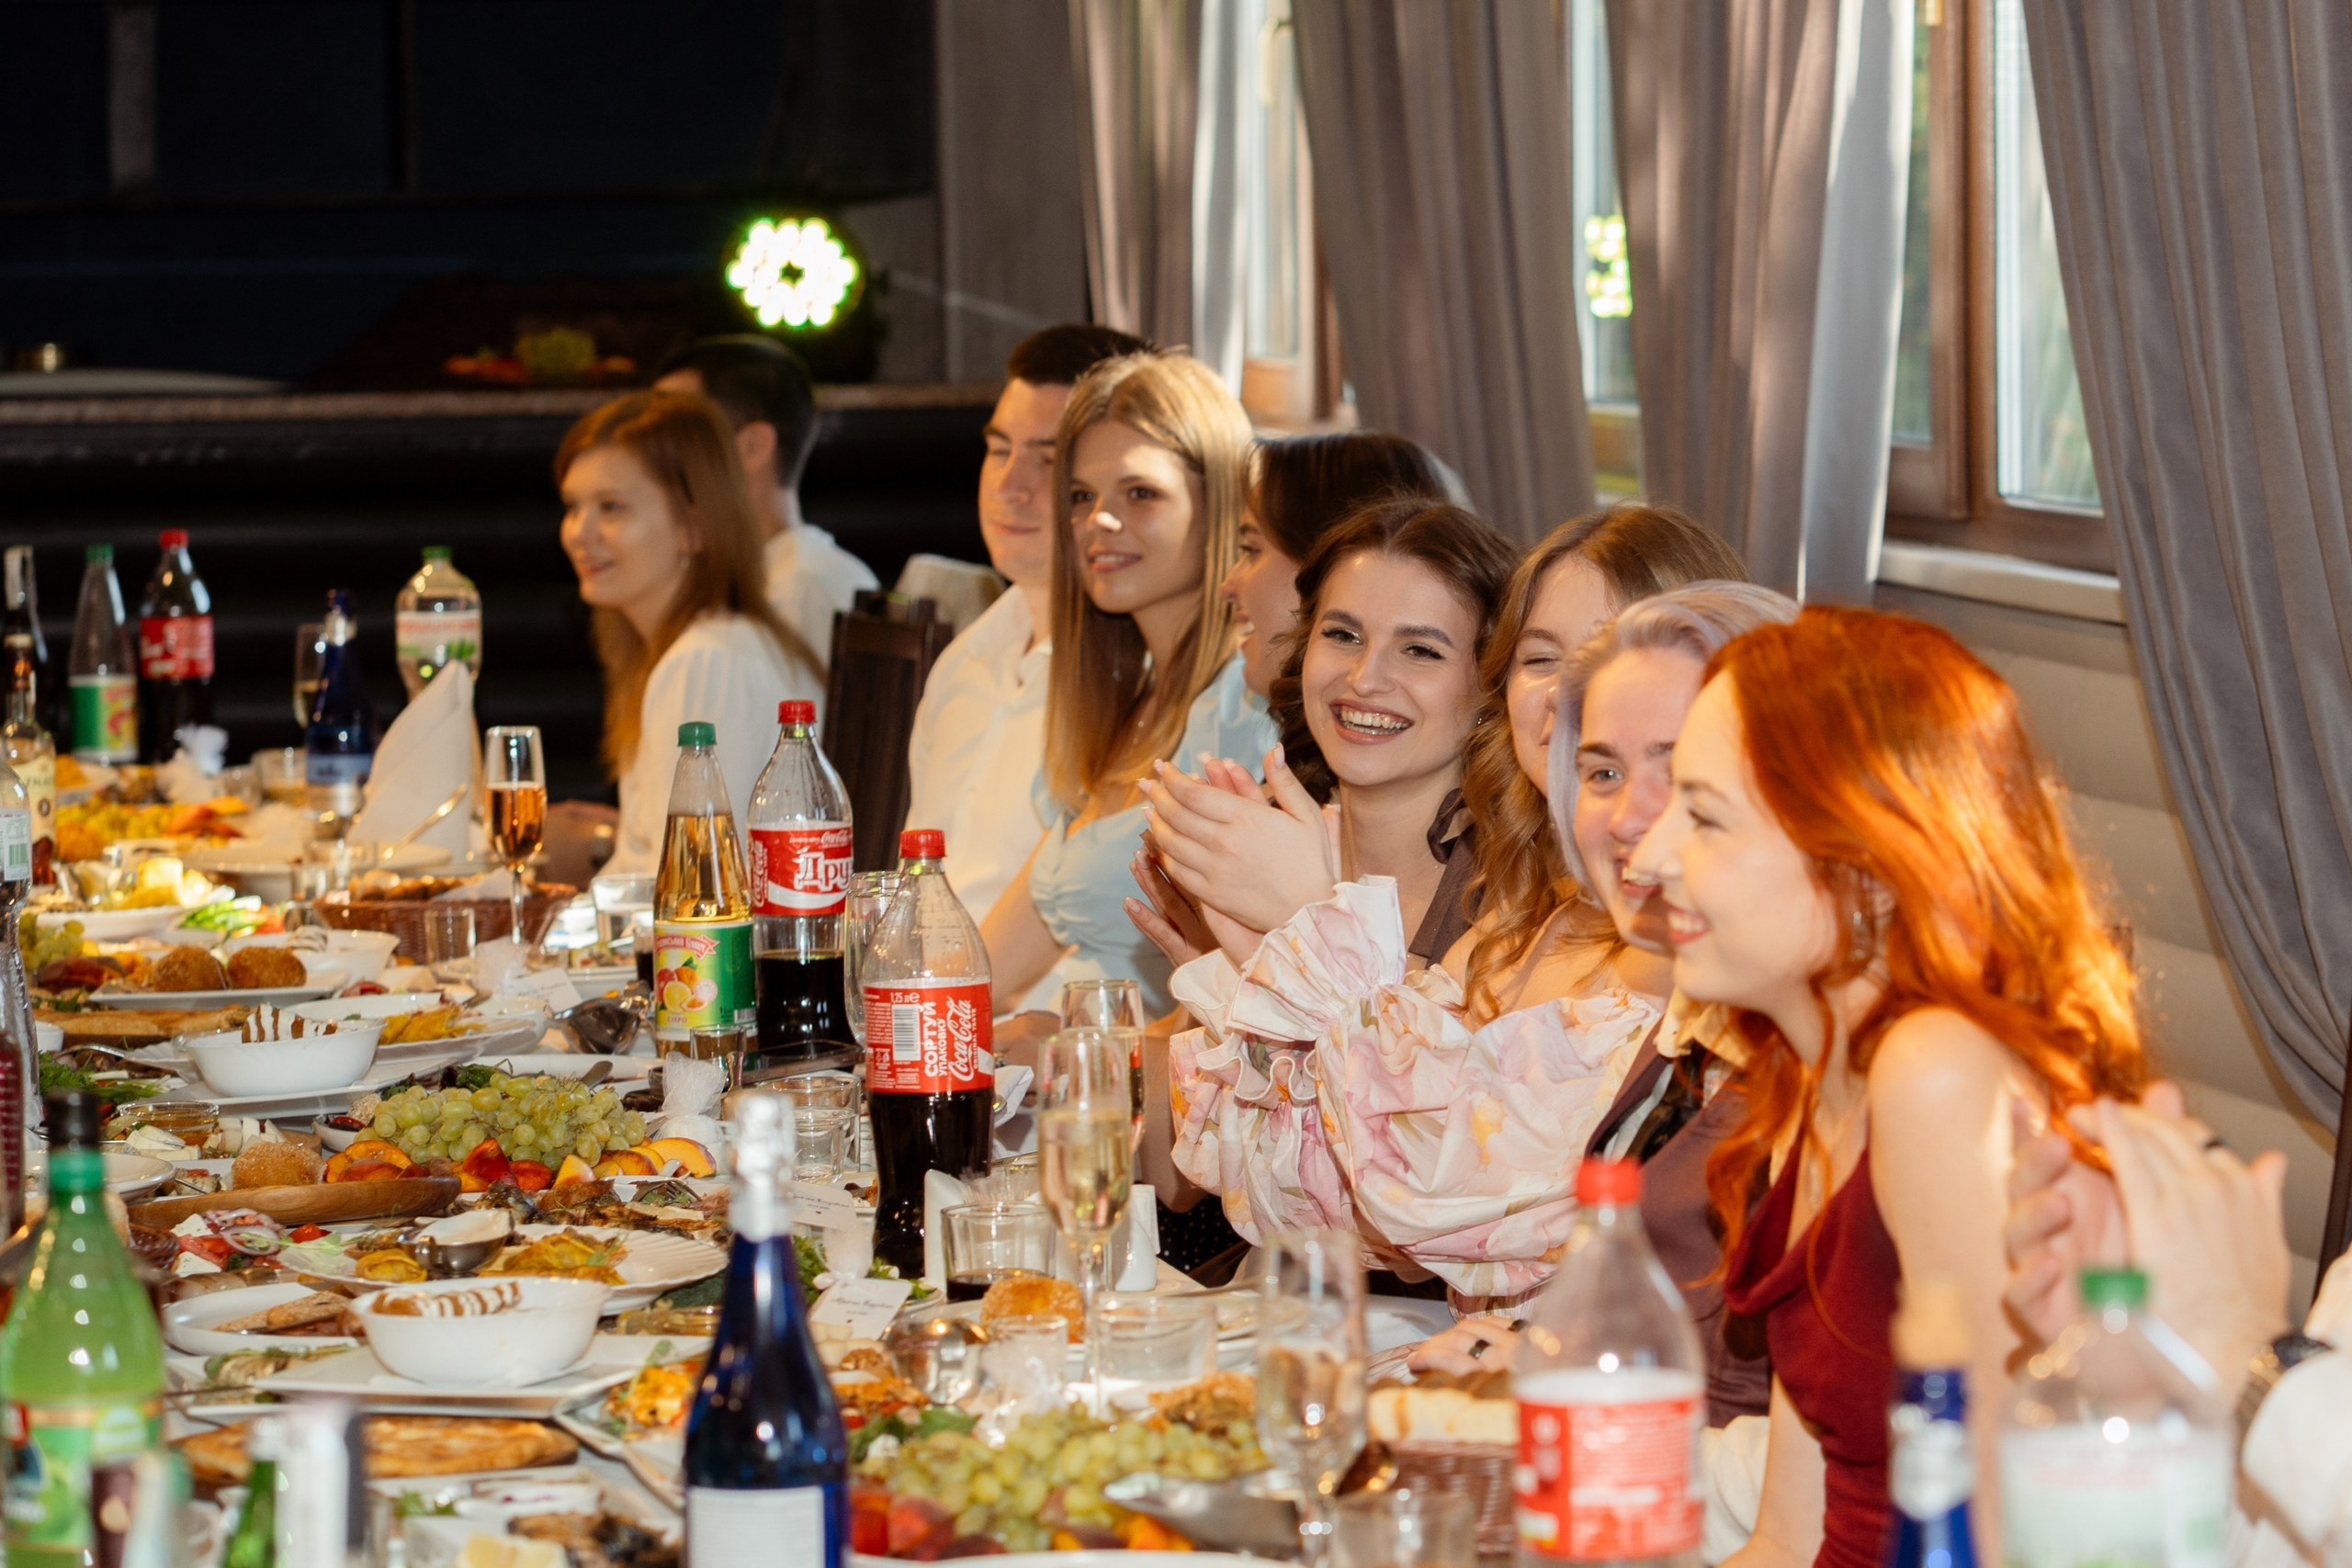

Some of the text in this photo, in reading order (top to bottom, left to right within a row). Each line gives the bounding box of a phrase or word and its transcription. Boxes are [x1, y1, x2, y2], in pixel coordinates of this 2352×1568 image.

[890, 992, 903, 1003] 1,25
[919, 1001, 938, 1077] СОРТУЙ
[937, 1018, 947, 1077] УПАКОВКУ
